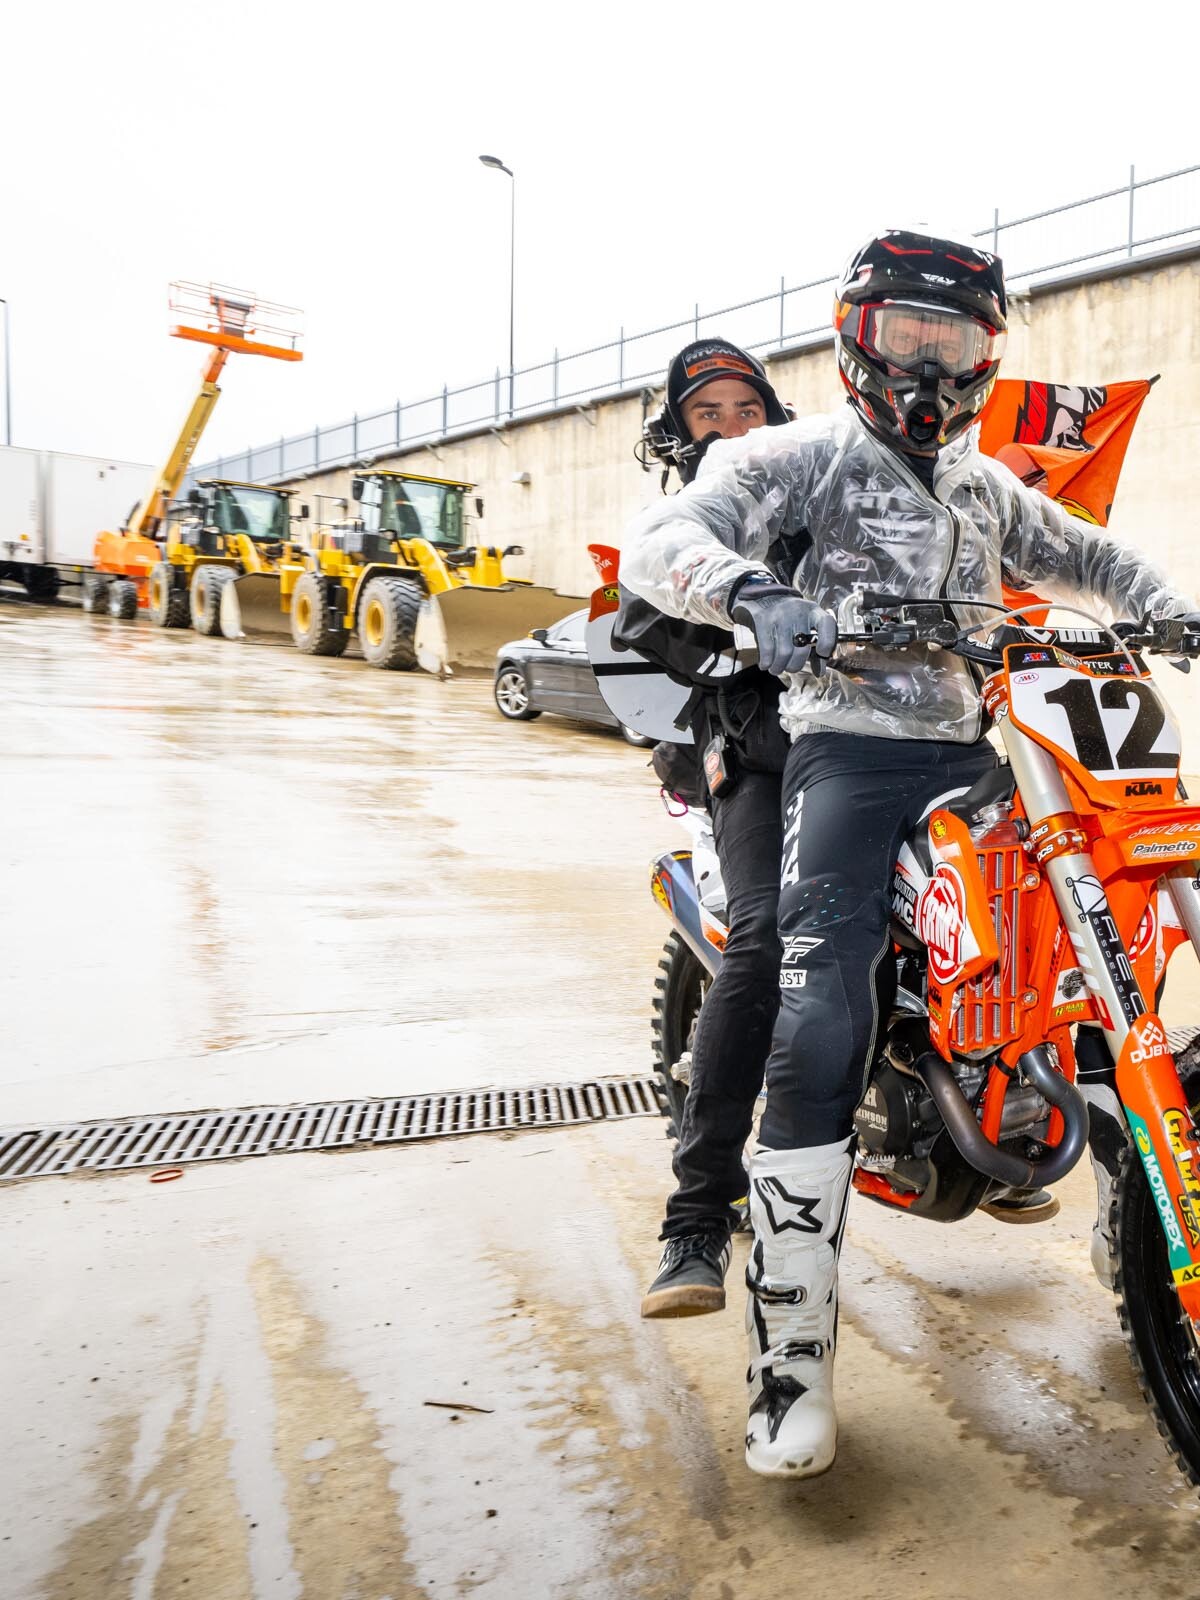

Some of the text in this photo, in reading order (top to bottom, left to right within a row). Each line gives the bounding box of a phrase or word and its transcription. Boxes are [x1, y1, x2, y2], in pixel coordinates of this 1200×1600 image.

[1044, 679, 1180, 770] 12
[1125, 781, 1163, 797] KTM
[1133, 841, 1197, 855] Palmetto
[1092, 917, 1135, 1022] SUSPENSION
[1130, 1043, 1170, 1064] DUBY
[1143, 1154, 1185, 1252] MOTOREX
[1178, 1194, 1200, 1248] USA
